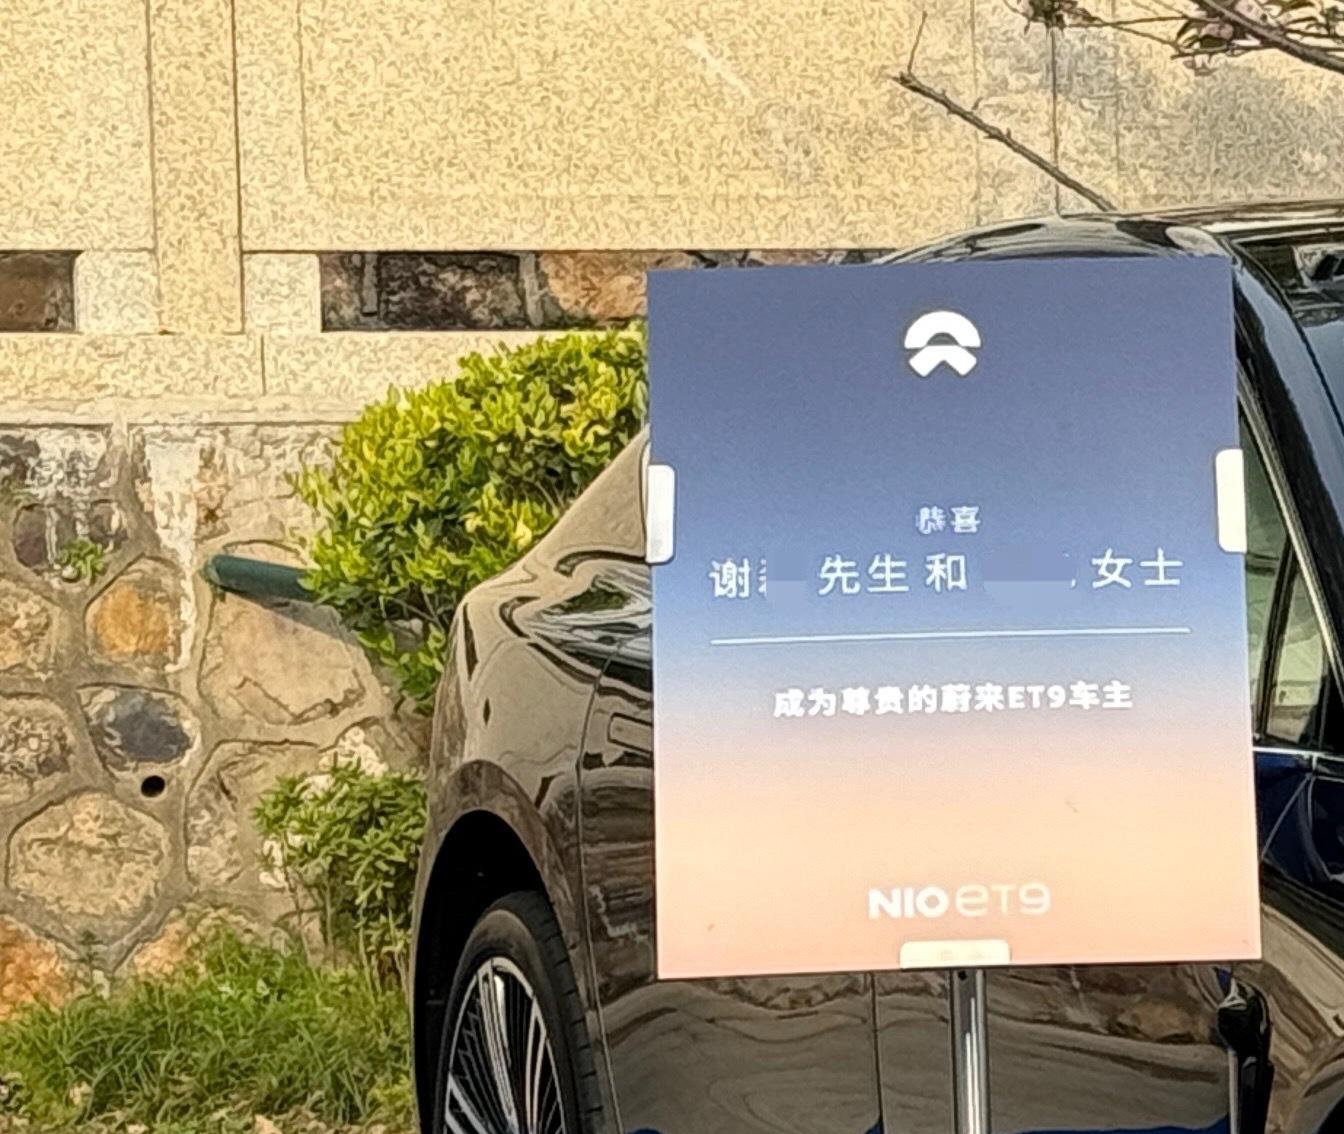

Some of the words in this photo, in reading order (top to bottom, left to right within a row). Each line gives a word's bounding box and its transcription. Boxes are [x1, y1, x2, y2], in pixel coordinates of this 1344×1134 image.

[916, 505, 981, 535] 恭喜
[818, 553, 910, 596] 先生
[925, 552, 968, 593] 和
[1091, 547, 1184, 590] 女士
[773, 680, 1134, 718] 成为尊贵的蔚来ET9车主
[867, 885, 950, 921] NIO
